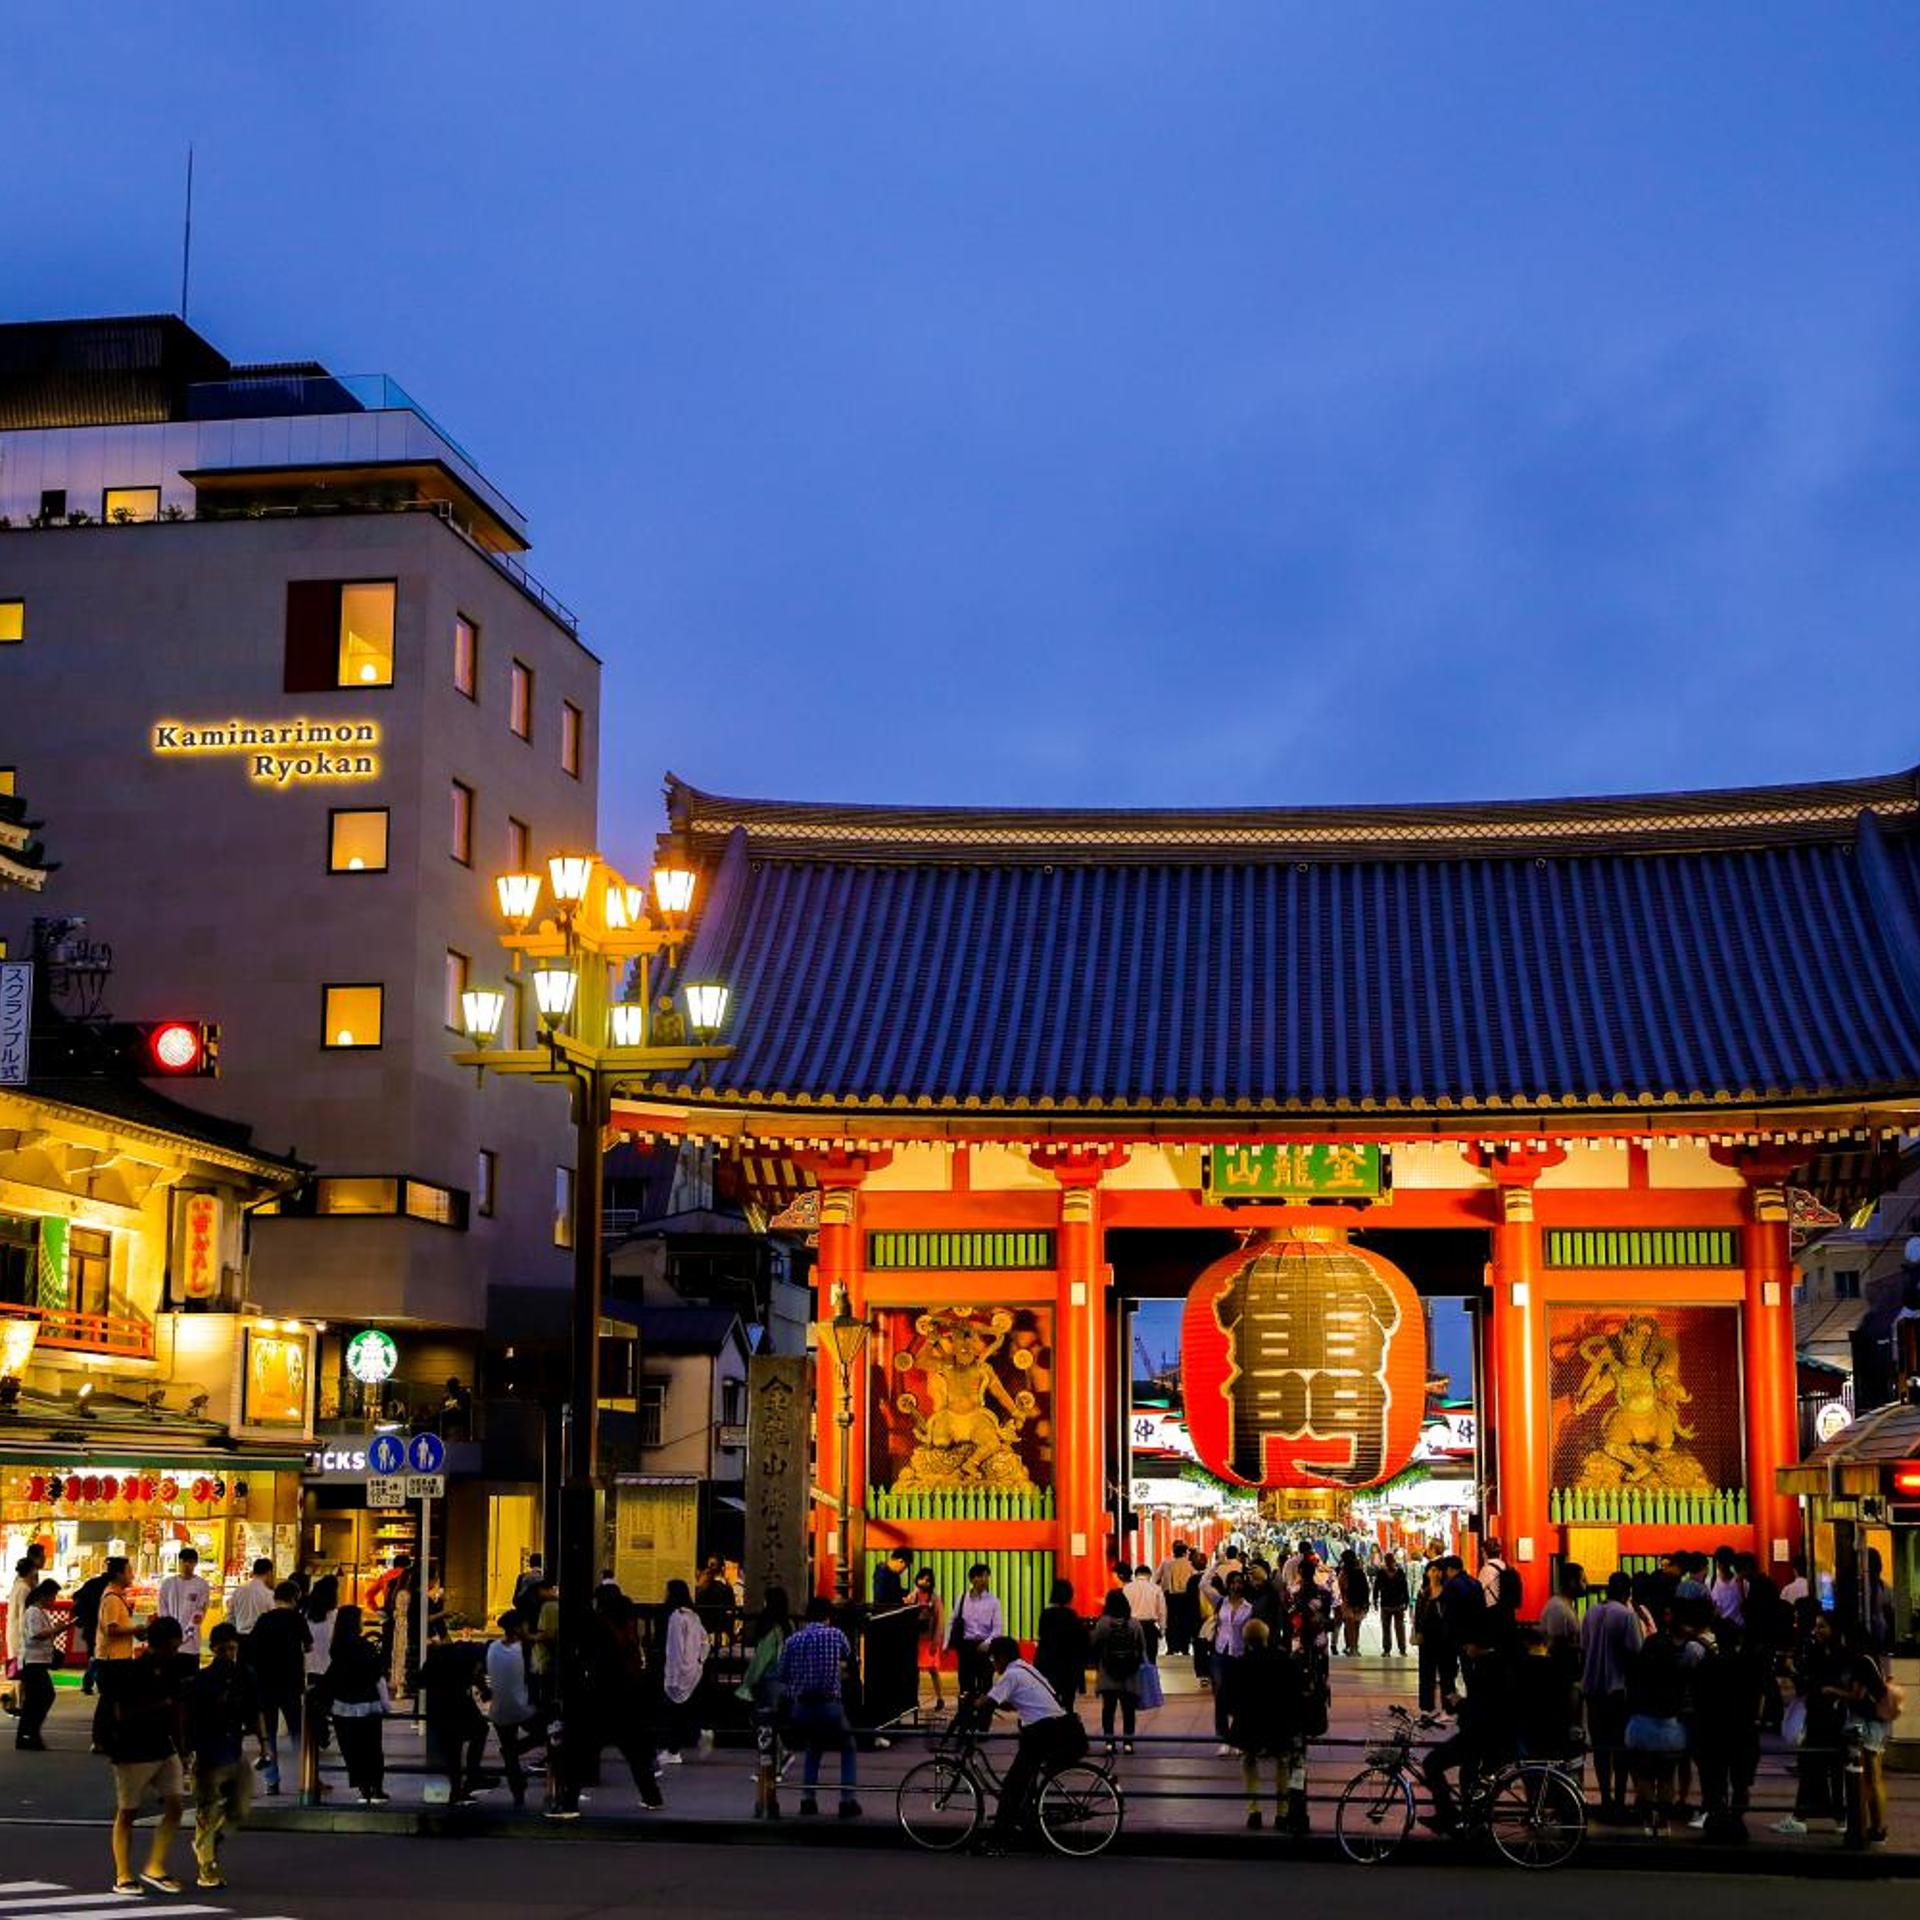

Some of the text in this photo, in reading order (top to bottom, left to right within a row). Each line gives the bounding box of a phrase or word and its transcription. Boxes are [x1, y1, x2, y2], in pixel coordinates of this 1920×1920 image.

[155, 722, 374, 748] Kaminarimon
[253, 753, 373, 781] Ryokan
[1211, 1253, 1401, 1486] 雷門
